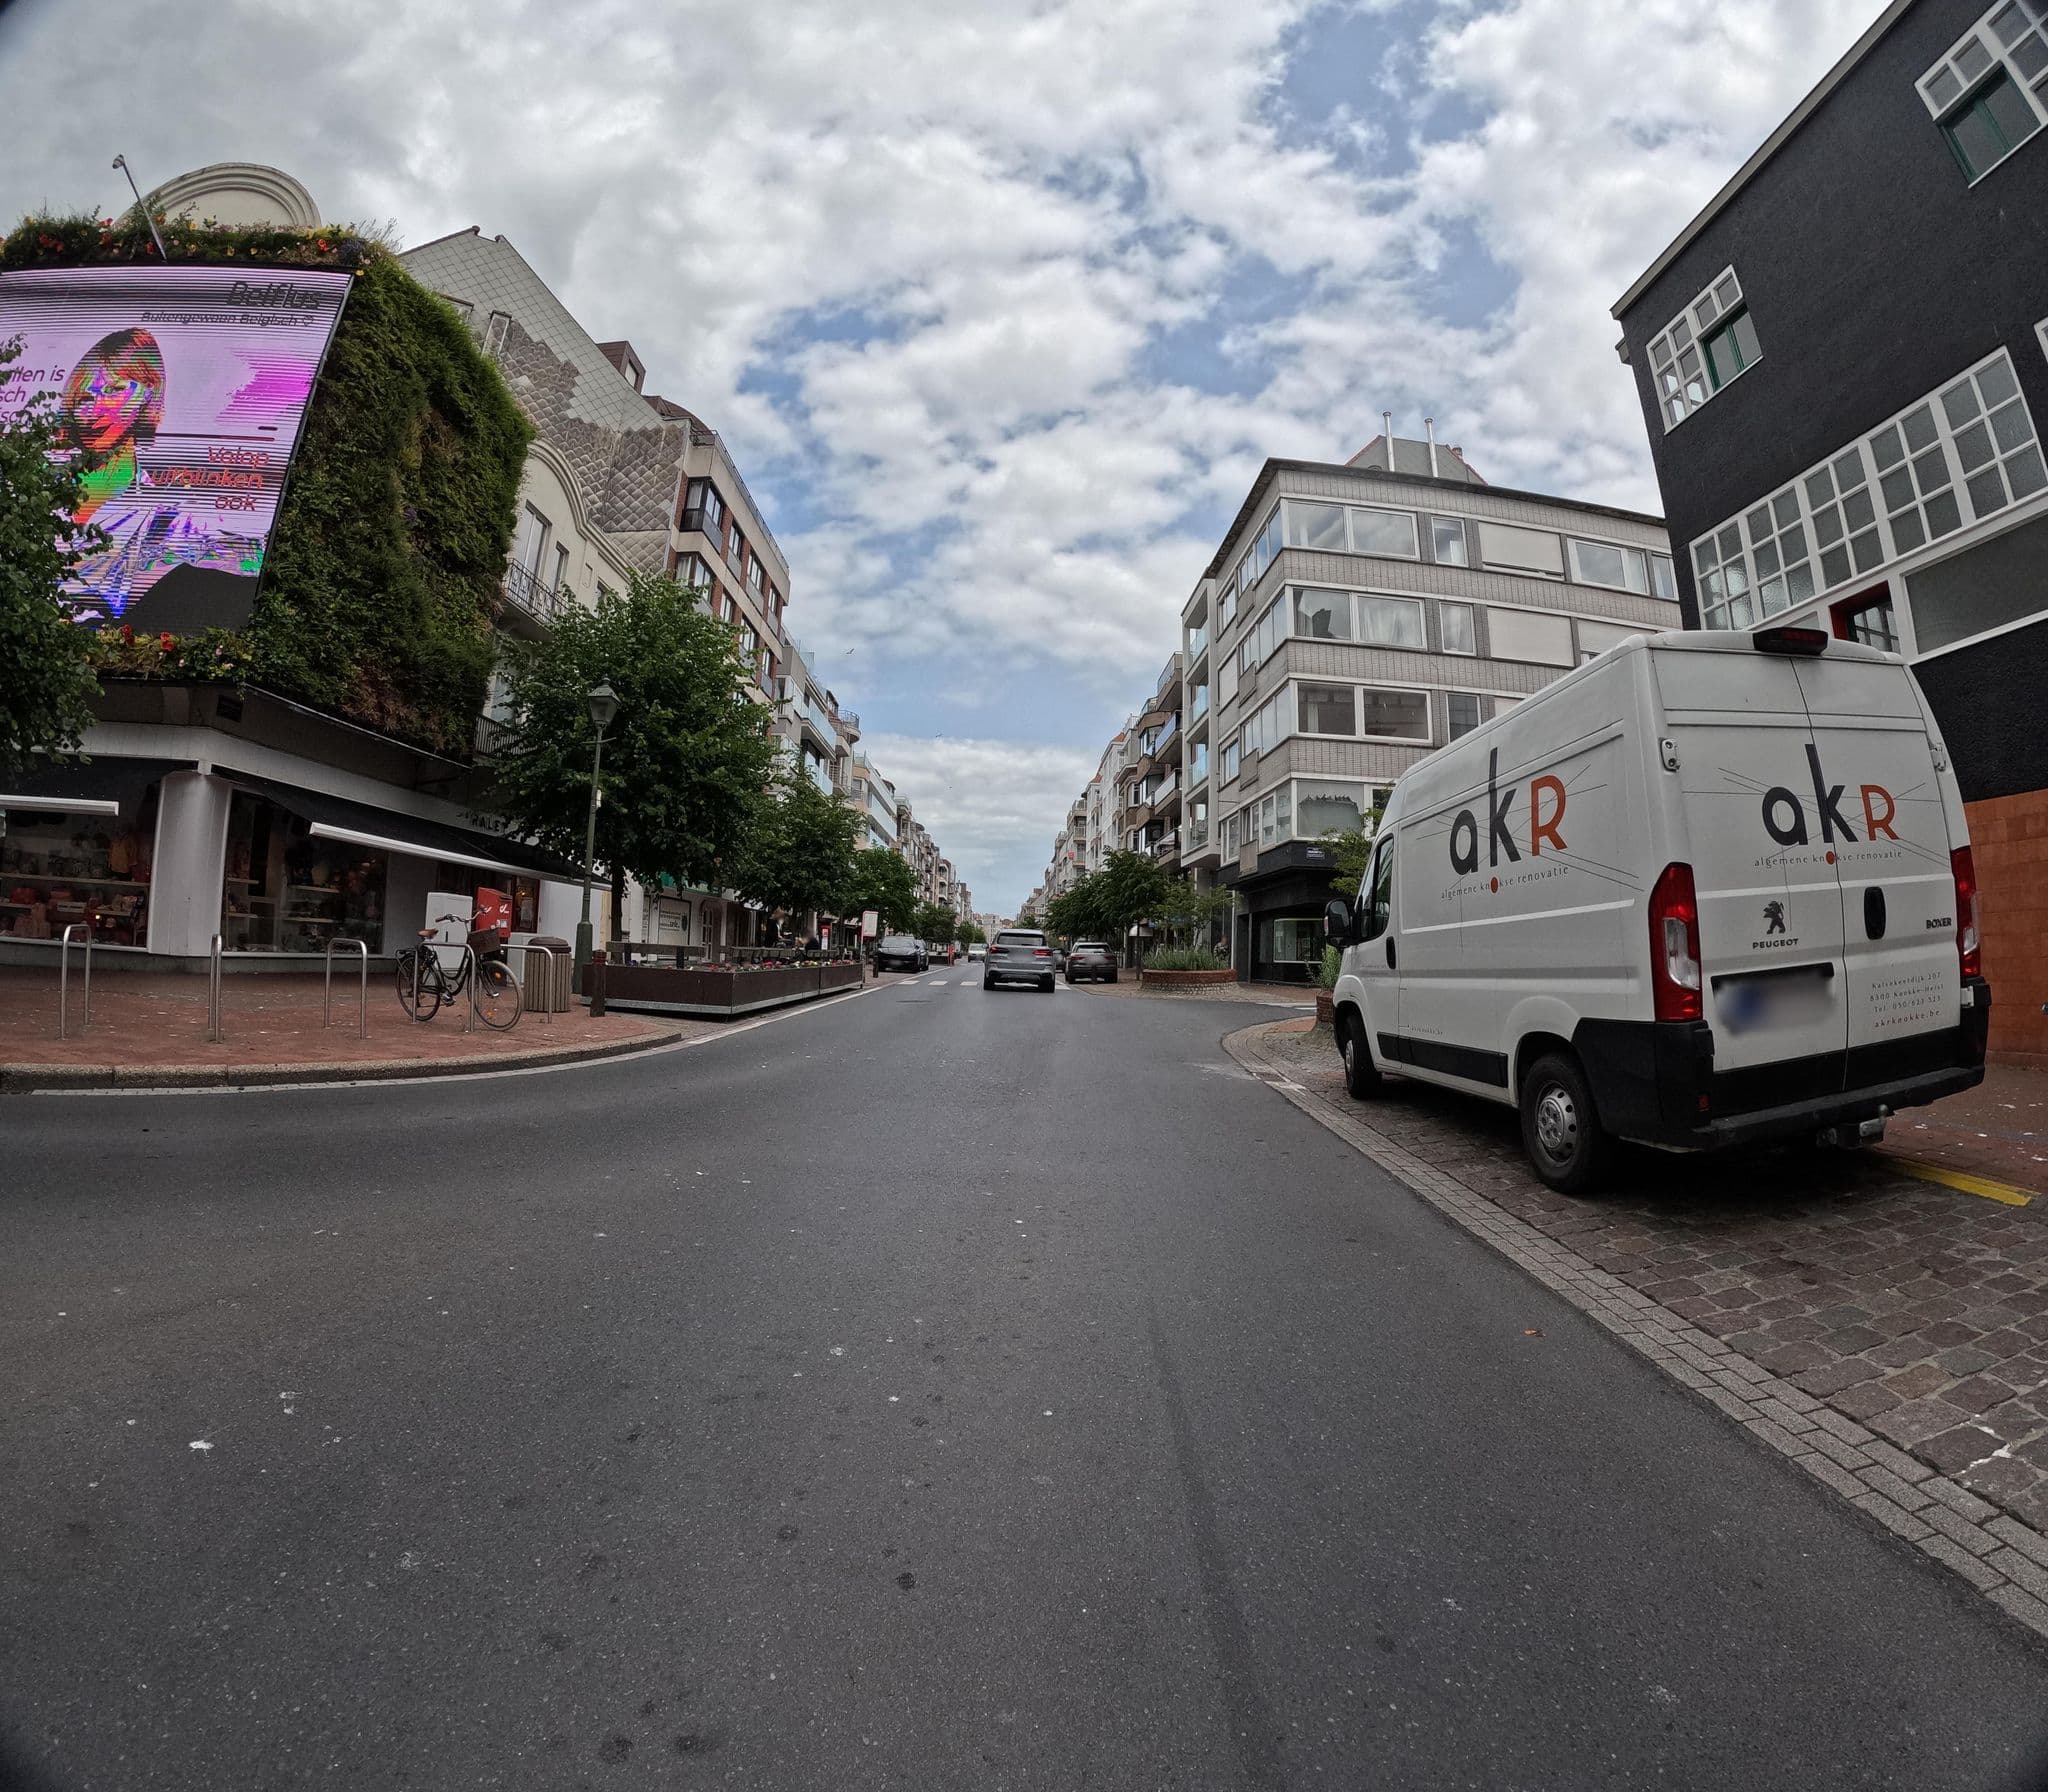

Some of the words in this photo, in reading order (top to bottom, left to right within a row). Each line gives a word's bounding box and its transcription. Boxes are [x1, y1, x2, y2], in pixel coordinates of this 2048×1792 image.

[226, 281, 321, 309] Belfius
[239, 313, 298, 327] Belgisch
[50, 364, 66, 381] is
[207, 446, 270, 469] Volop
[215, 493, 256, 511] ook
[1762, 744, 1900, 846] akR
[1450, 747, 1568, 875] akR
[1754, 855, 1808, 868] algemene
[1856, 850, 1902, 860] renovatie
[1441, 883, 1477, 900] algemene
[1517, 864, 1569, 883] renovatie
[1926, 917, 1952, 929] BOXER
[1752, 938, 1799, 949] PEUGEOT
